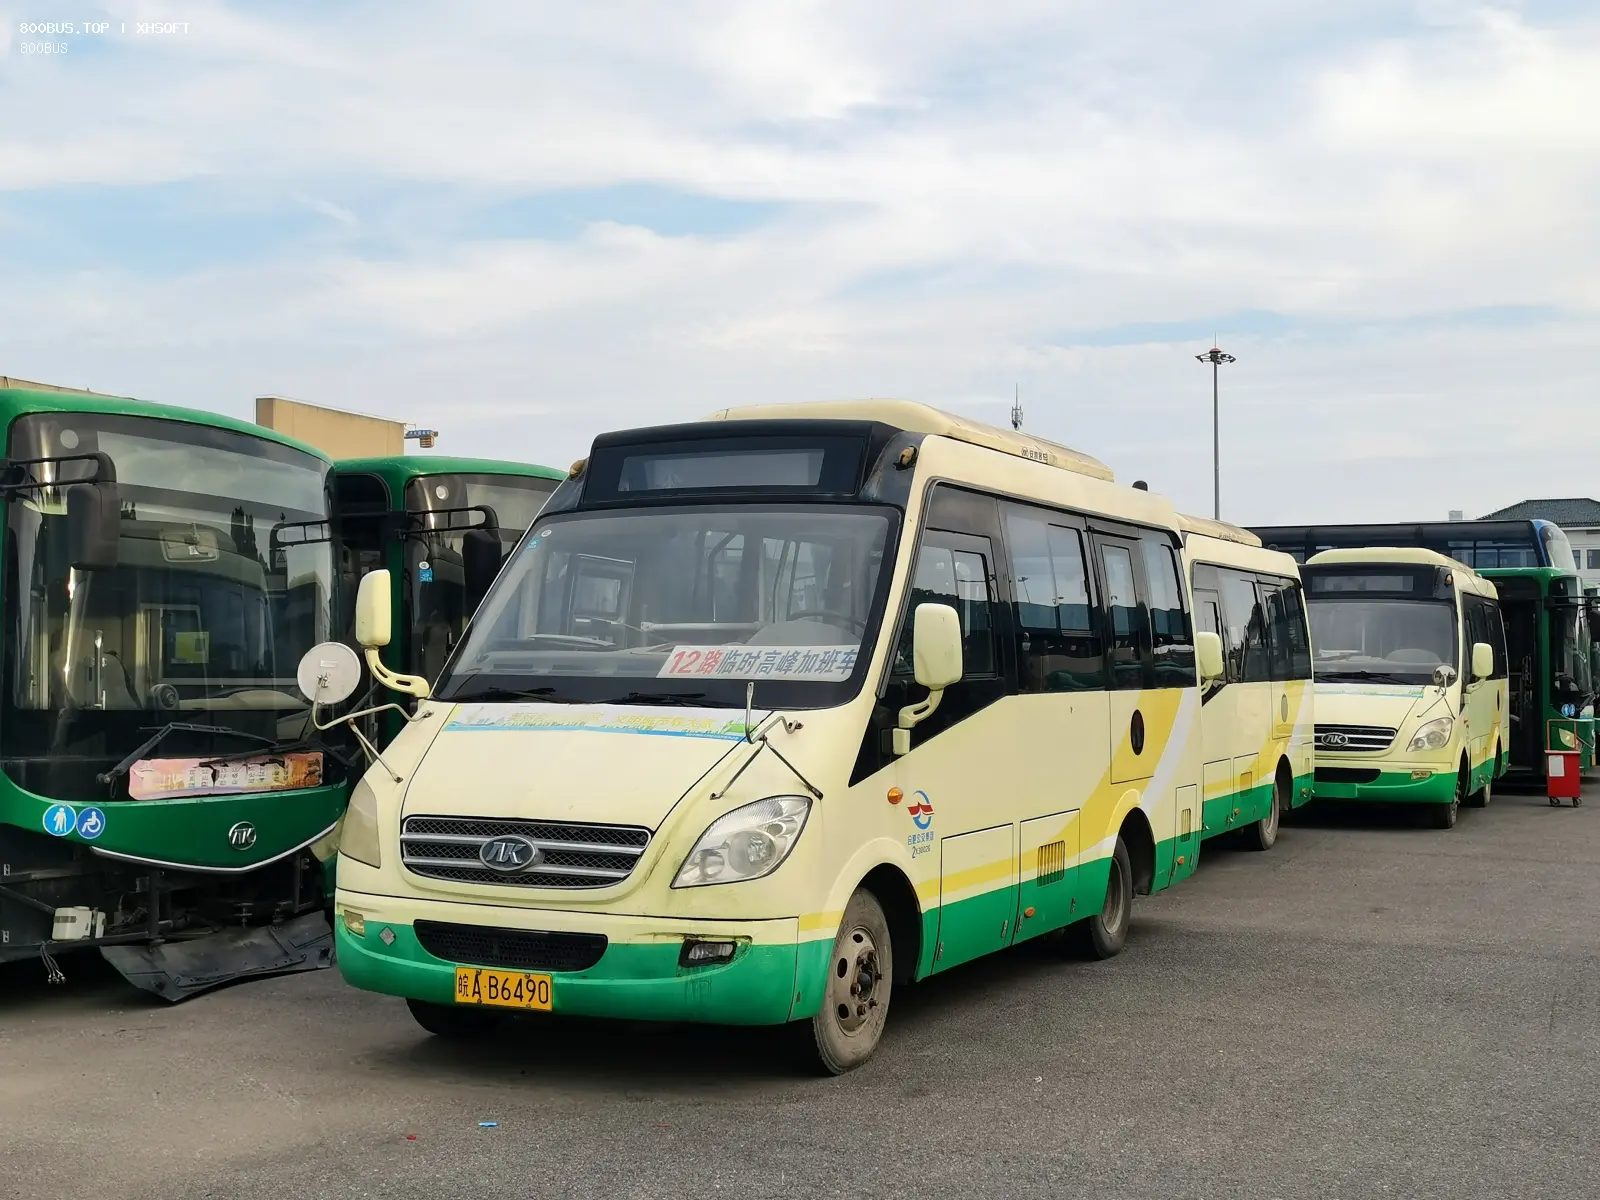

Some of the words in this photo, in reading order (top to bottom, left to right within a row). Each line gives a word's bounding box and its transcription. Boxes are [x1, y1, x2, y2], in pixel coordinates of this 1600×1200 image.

[667, 649, 858, 676] 12路临时高峰加班车
